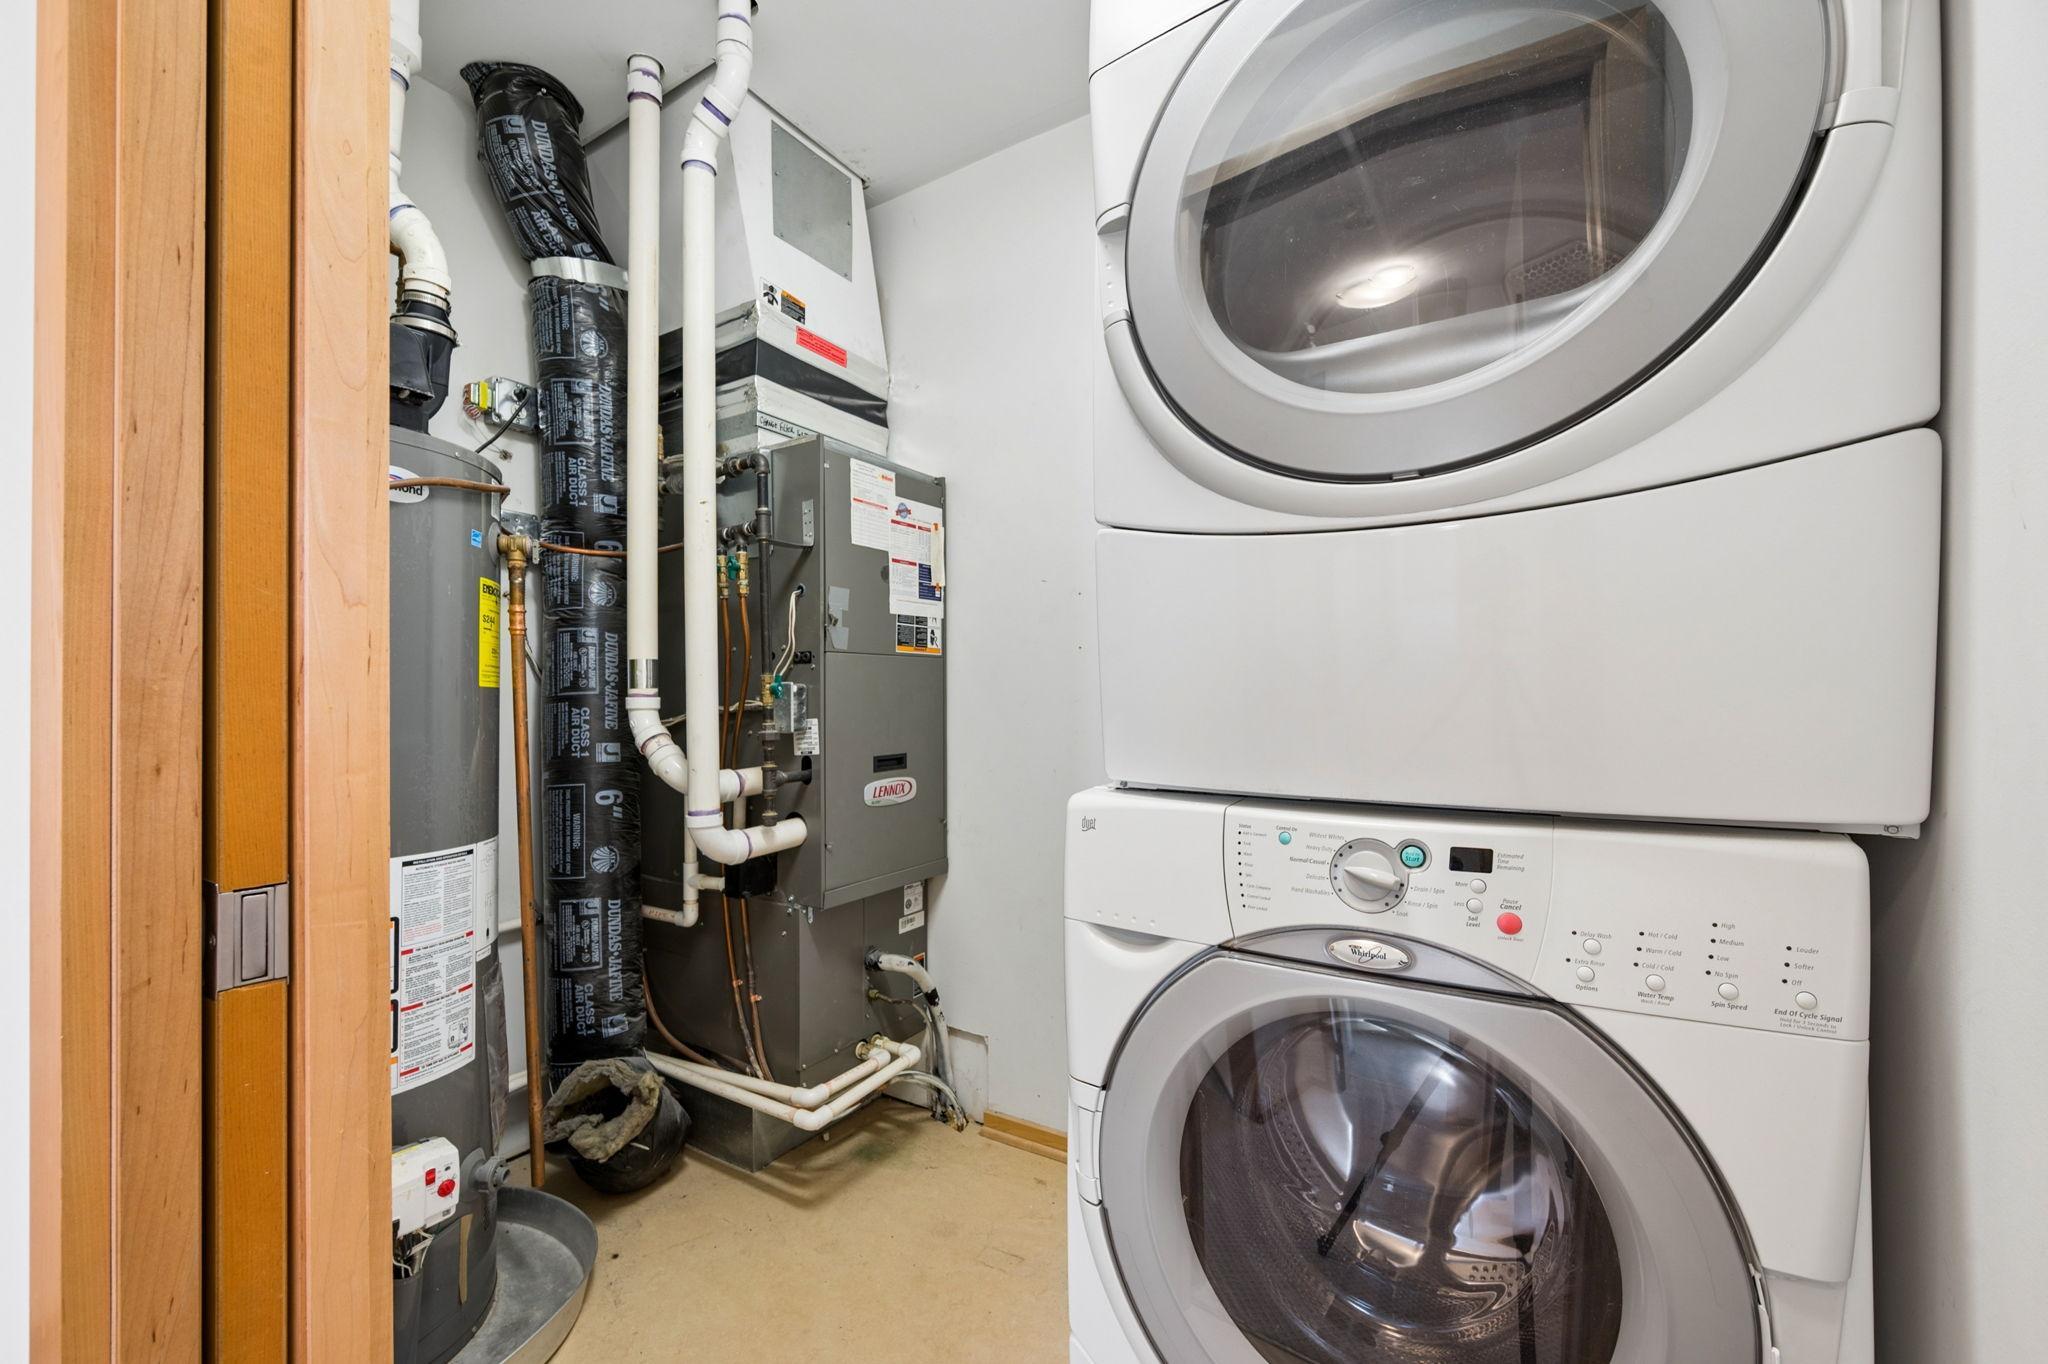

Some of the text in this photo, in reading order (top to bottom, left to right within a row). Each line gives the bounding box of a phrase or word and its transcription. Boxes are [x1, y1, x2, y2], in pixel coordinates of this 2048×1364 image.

[531, 210, 547, 231] AIR
[568, 457, 578, 507] AIR DUCT
[578, 456, 588, 496] CLASS
[571, 708, 581, 759] AIR DUCT
[581, 706, 590, 747] CLASS
[873, 782, 907, 798] LENNOX
[1082, 816, 1096, 832] duet
[1720, 938, 1744, 946] Medium
[1796, 946, 1820, 954] Louder
[1351, 948, 1386, 960] Whirlpool
[1794, 962, 1814, 970] Softer
[1576, 984, 1598, 992] Options
[584, 983, 595, 1024] CLASS
[1638, 991, 1674, 1002] Water Temp
[574, 984, 586, 1037] AIR DUCT
[1712, 1000, 1748, 1011] Spin Speed
[1800, 1012, 1818, 1020] Cycle
[1820, 1014, 1843, 1023] Signal
